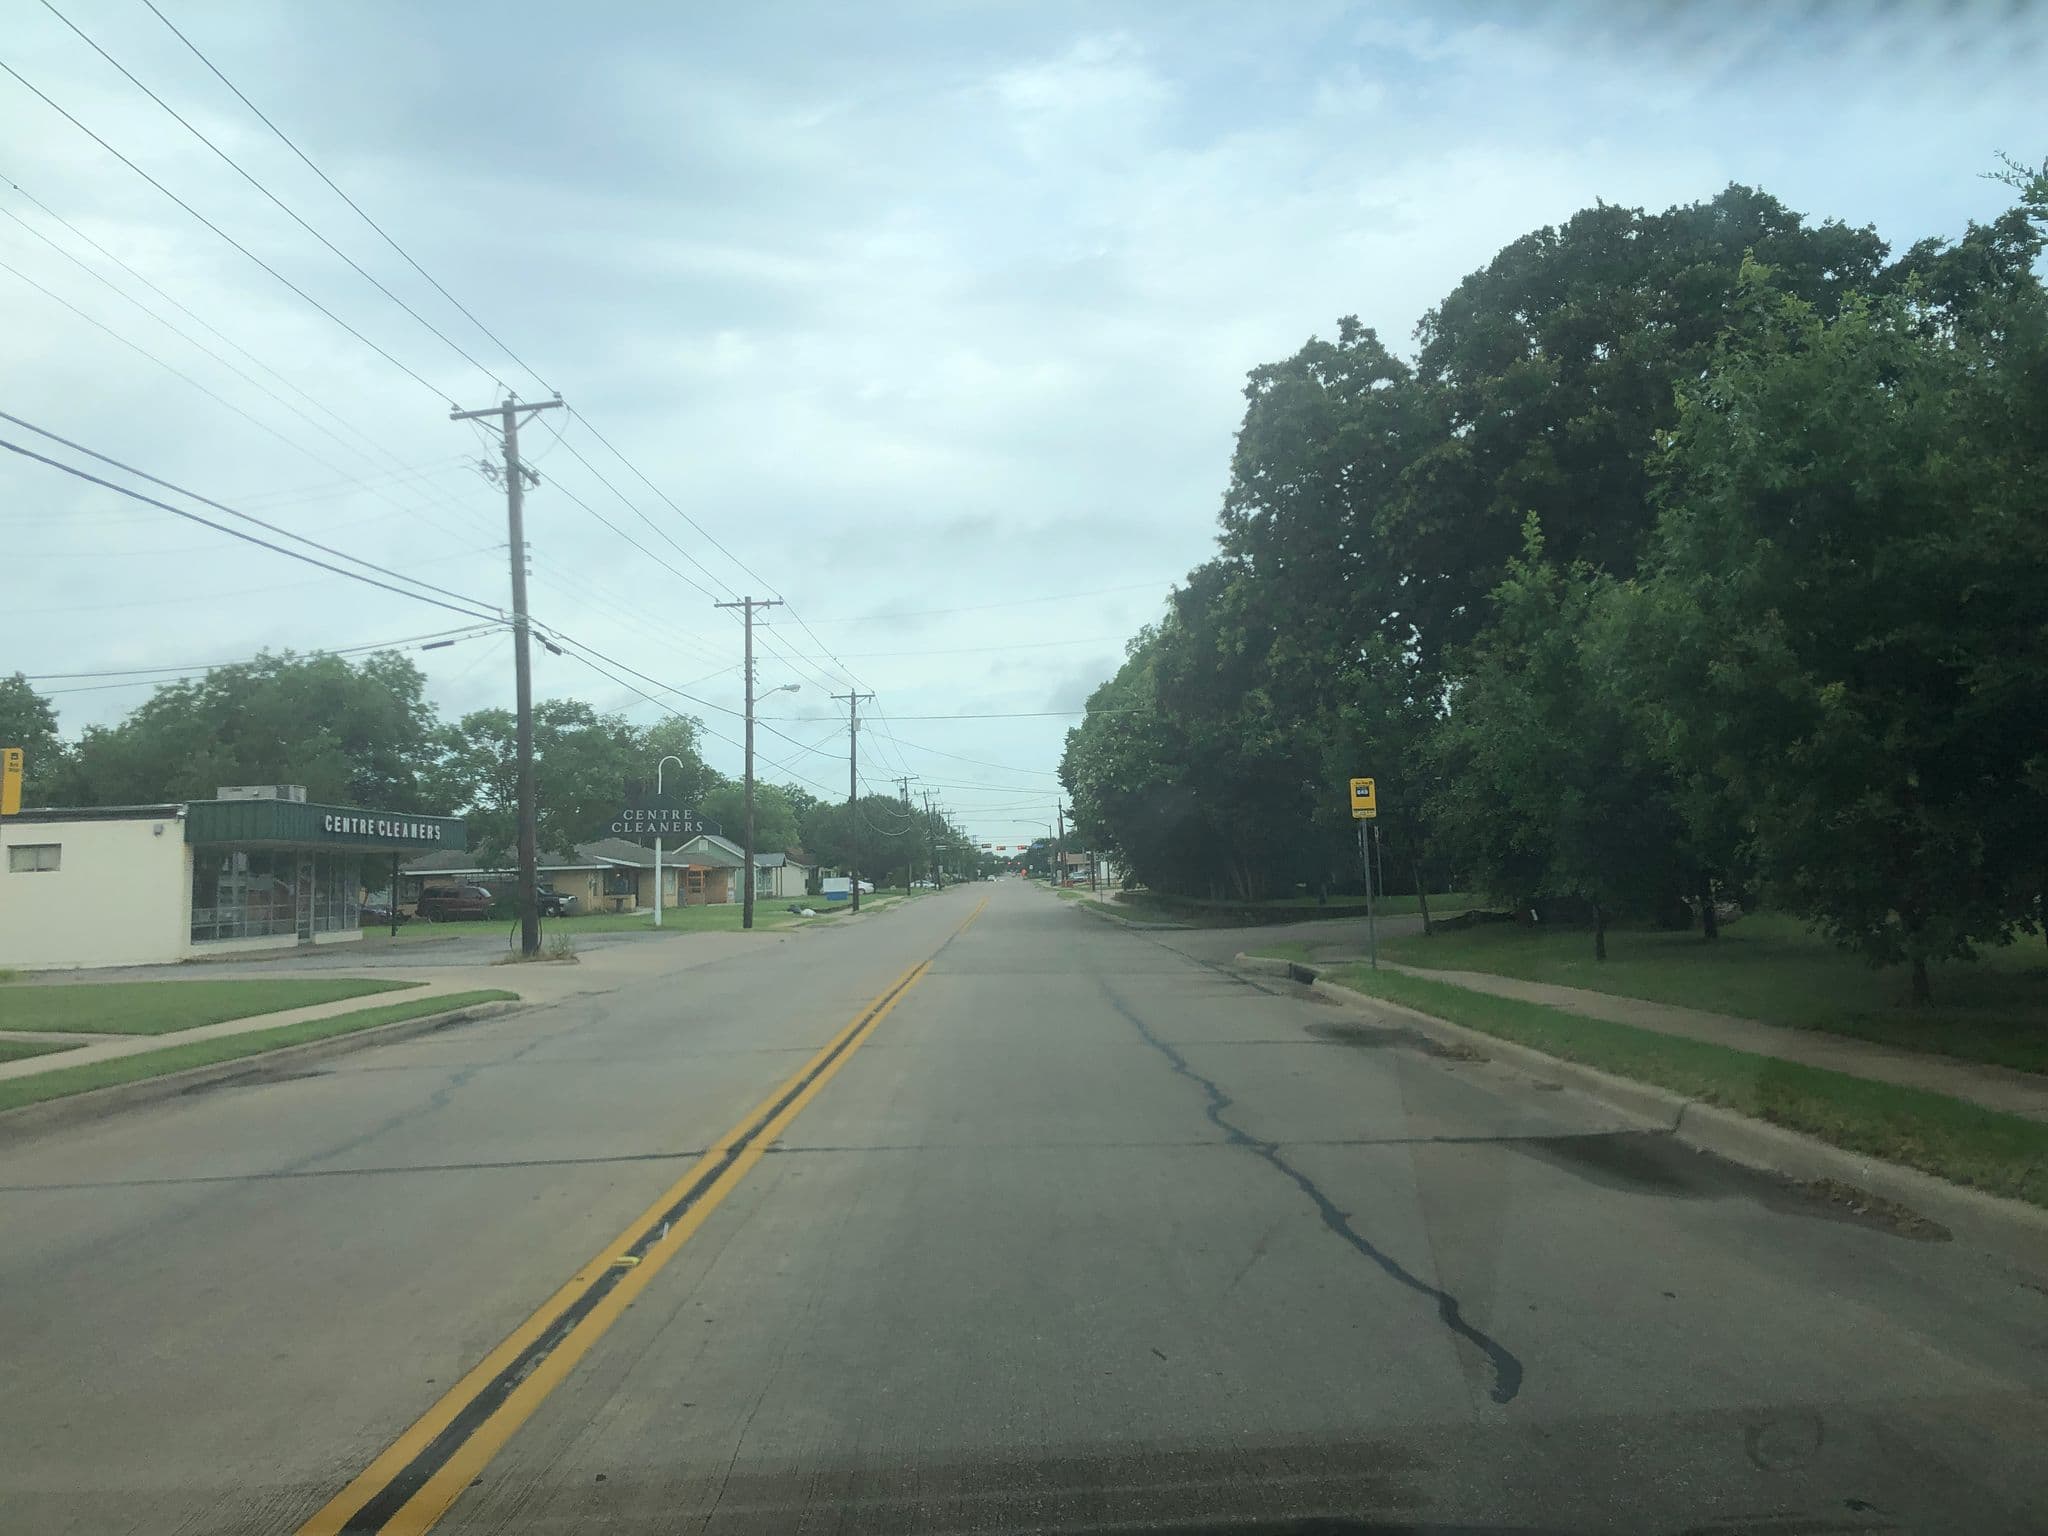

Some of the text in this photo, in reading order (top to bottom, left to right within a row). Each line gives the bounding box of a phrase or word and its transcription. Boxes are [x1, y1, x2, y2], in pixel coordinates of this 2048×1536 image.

[622, 809, 693, 820] CENTRE
[325, 814, 441, 841] CENTRE CLEANERS
[611, 821, 704, 833] CLEANERS
